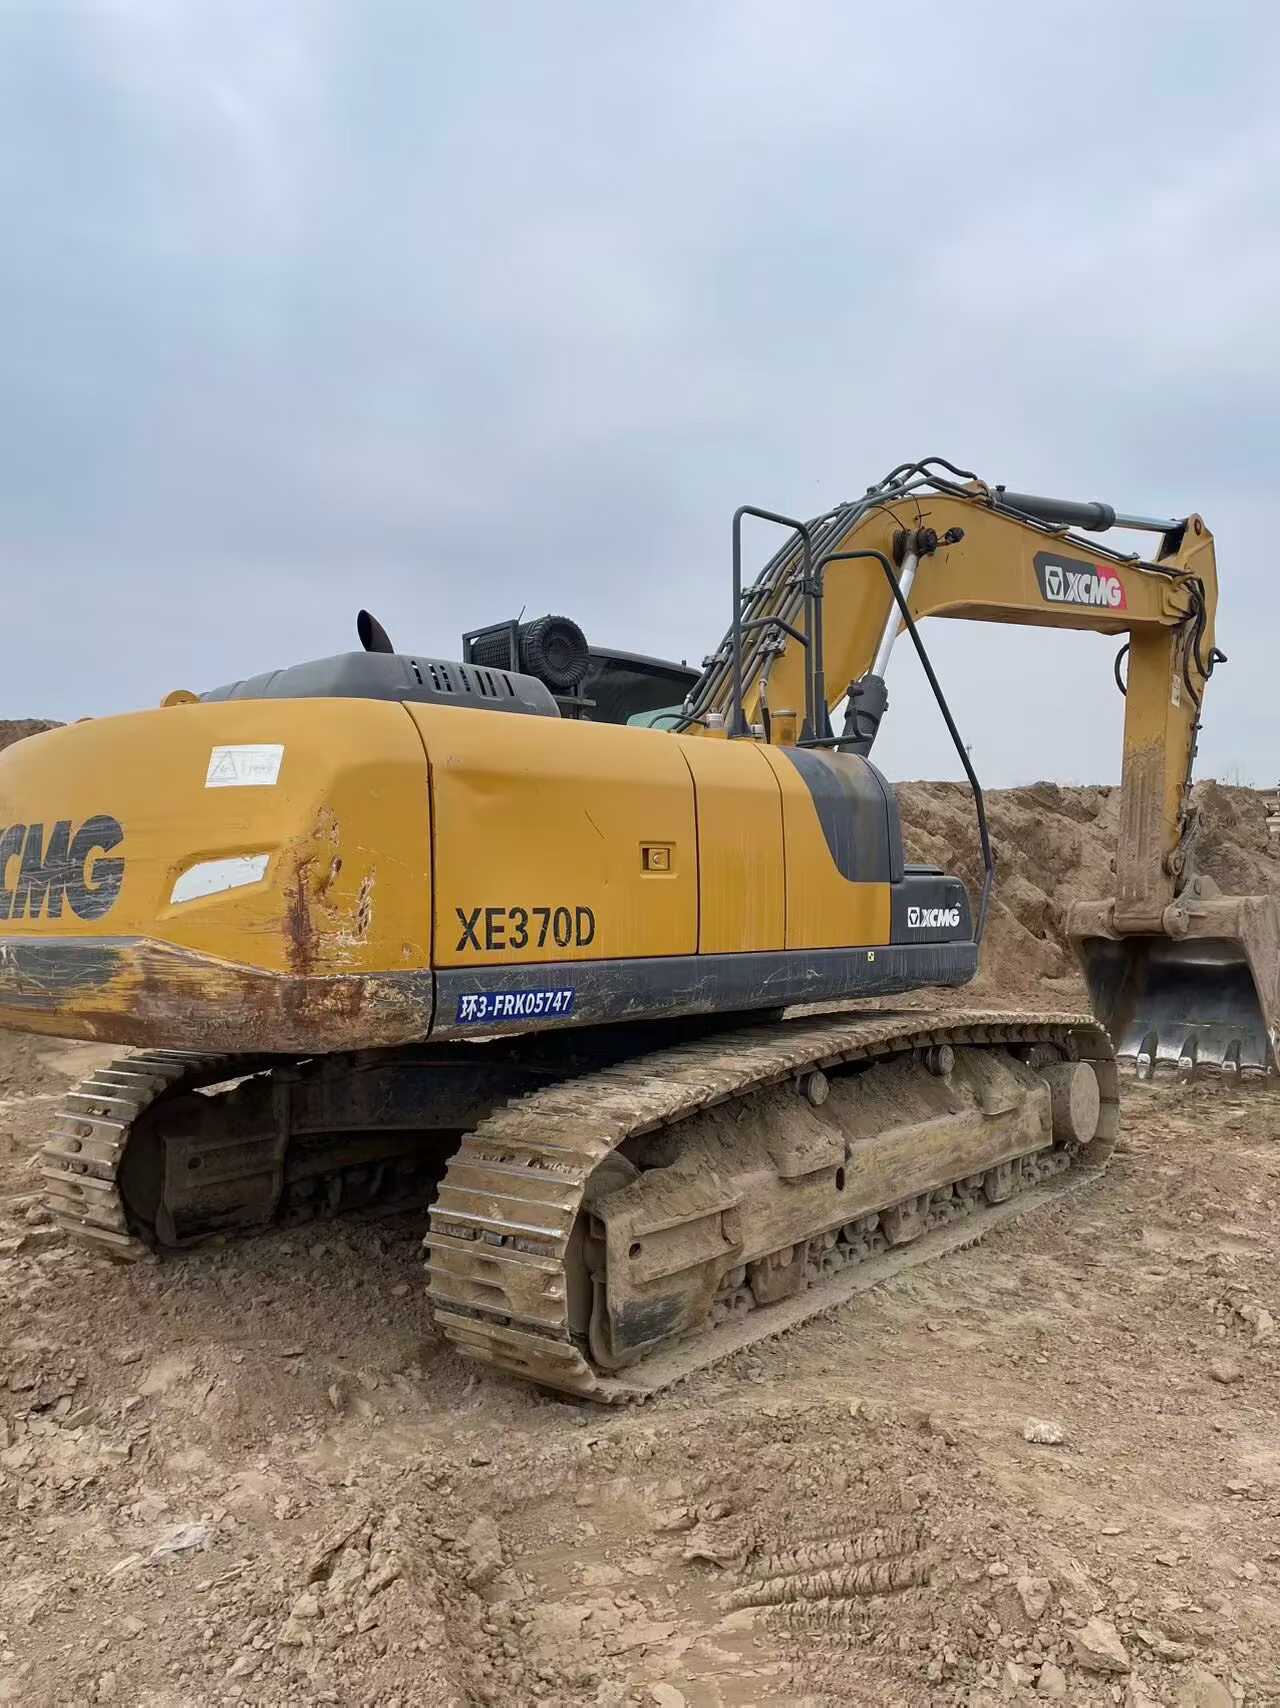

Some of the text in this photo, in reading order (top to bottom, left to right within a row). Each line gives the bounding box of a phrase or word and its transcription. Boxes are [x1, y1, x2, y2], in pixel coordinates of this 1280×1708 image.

[1064, 571, 1122, 607] XCMG
[0, 814, 125, 920] CMG
[455, 906, 596, 951] XE370D
[920, 908, 960, 928] XCMG
[459, 991, 572, 1021] 环3-FRK05747
